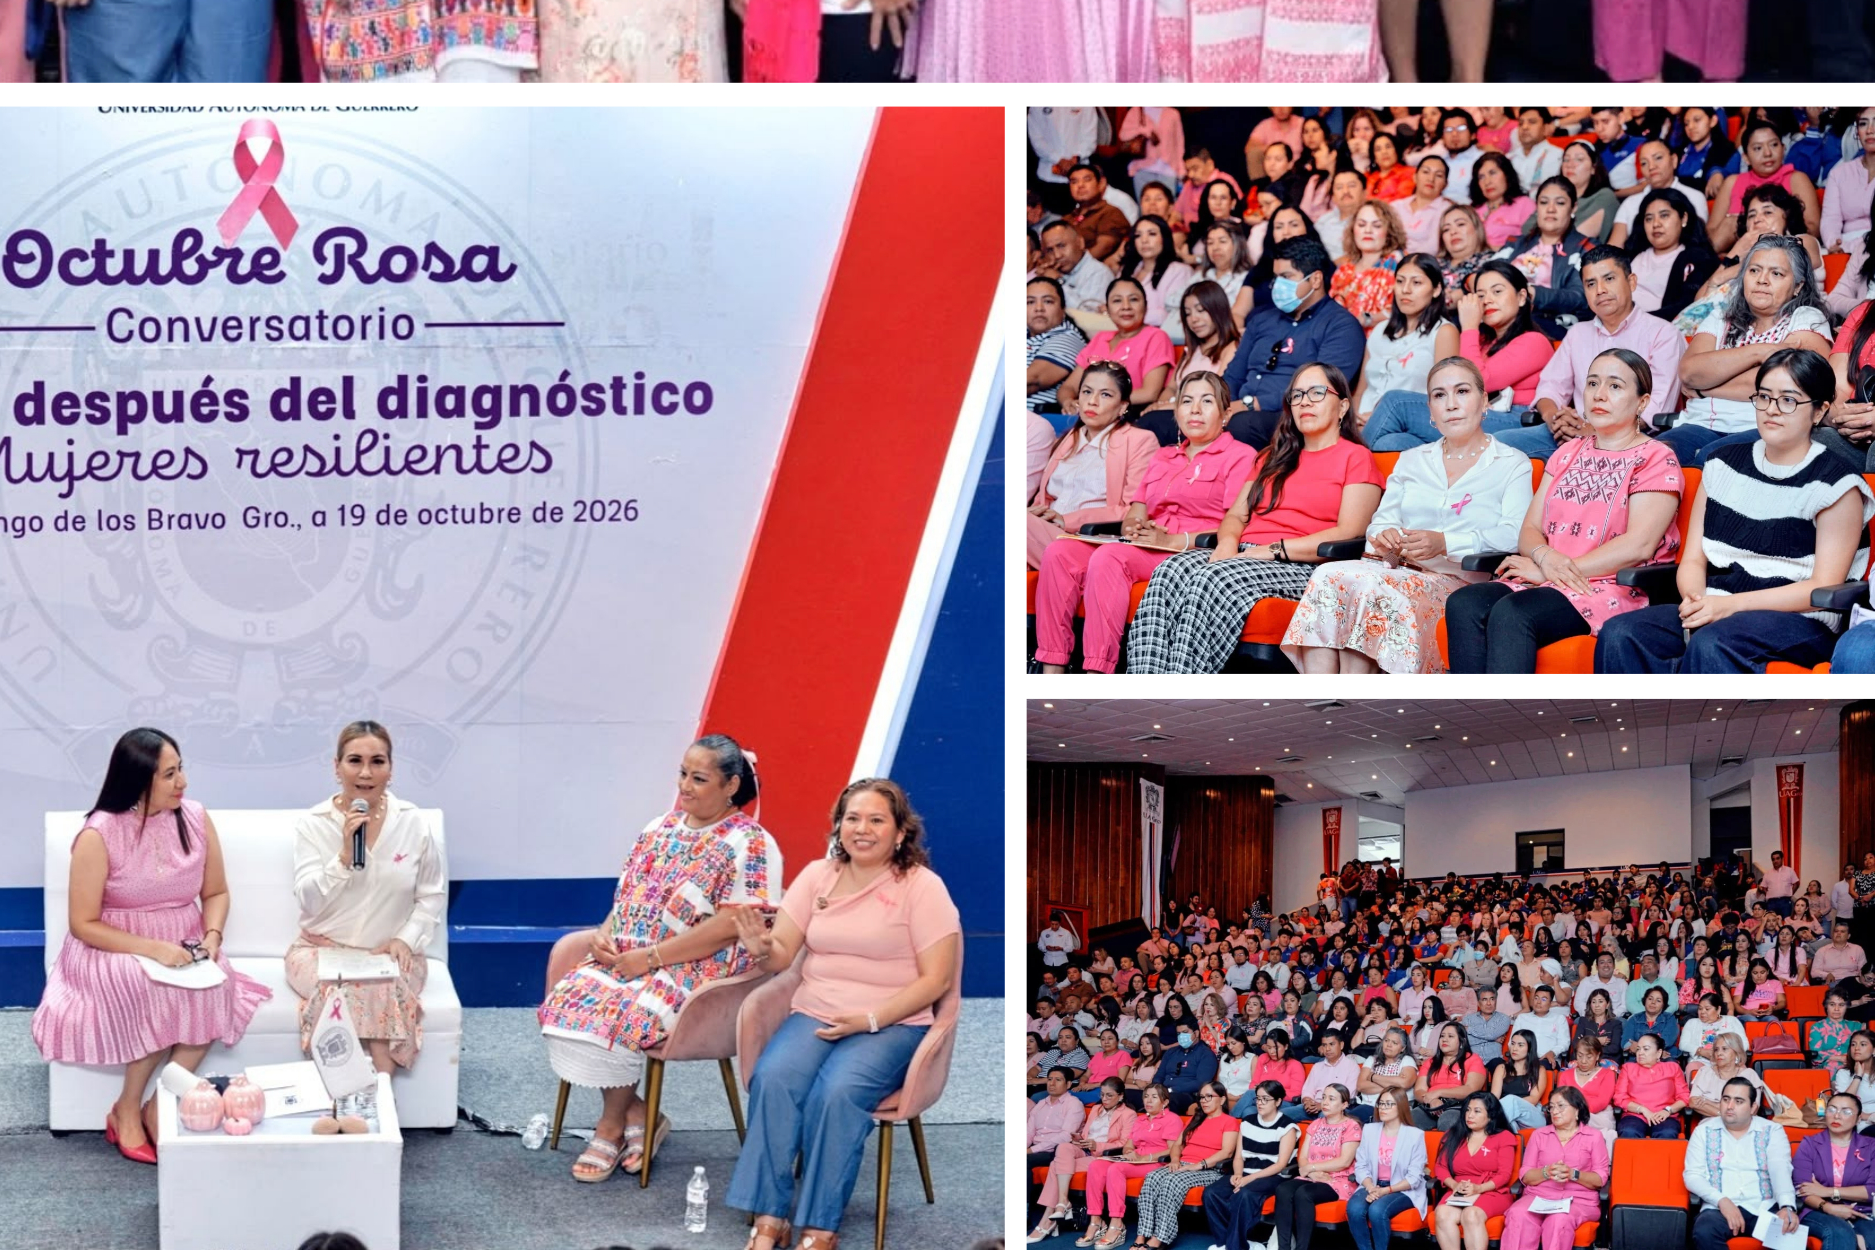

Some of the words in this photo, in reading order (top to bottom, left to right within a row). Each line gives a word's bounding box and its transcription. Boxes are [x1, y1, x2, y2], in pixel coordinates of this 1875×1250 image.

[1, 227, 287, 289] Octubre
[312, 226, 518, 286] Rosa
[106, 306, 415, 344] Conversatorio
[13, 374, 250, 436] después
[269, 375, 356, 422] del
[376, 368, 714, 431] diagnóstico
[235, 428, 553, 479] resilientes
[53, 509, 86, 532] de
[97, 509, 136, 532] los
[147, 508, 226, 531] Bravo
[242, 505, 303, 532] Gro.,
[311, 510, 327, 528] a
[337, 503, 366, 527] 19
[375, 503, 408, 526] de
[417, 502, 521, 525] octubre
[532, 500, 564, 524] de
[573, 499, 639, 523] 2026
